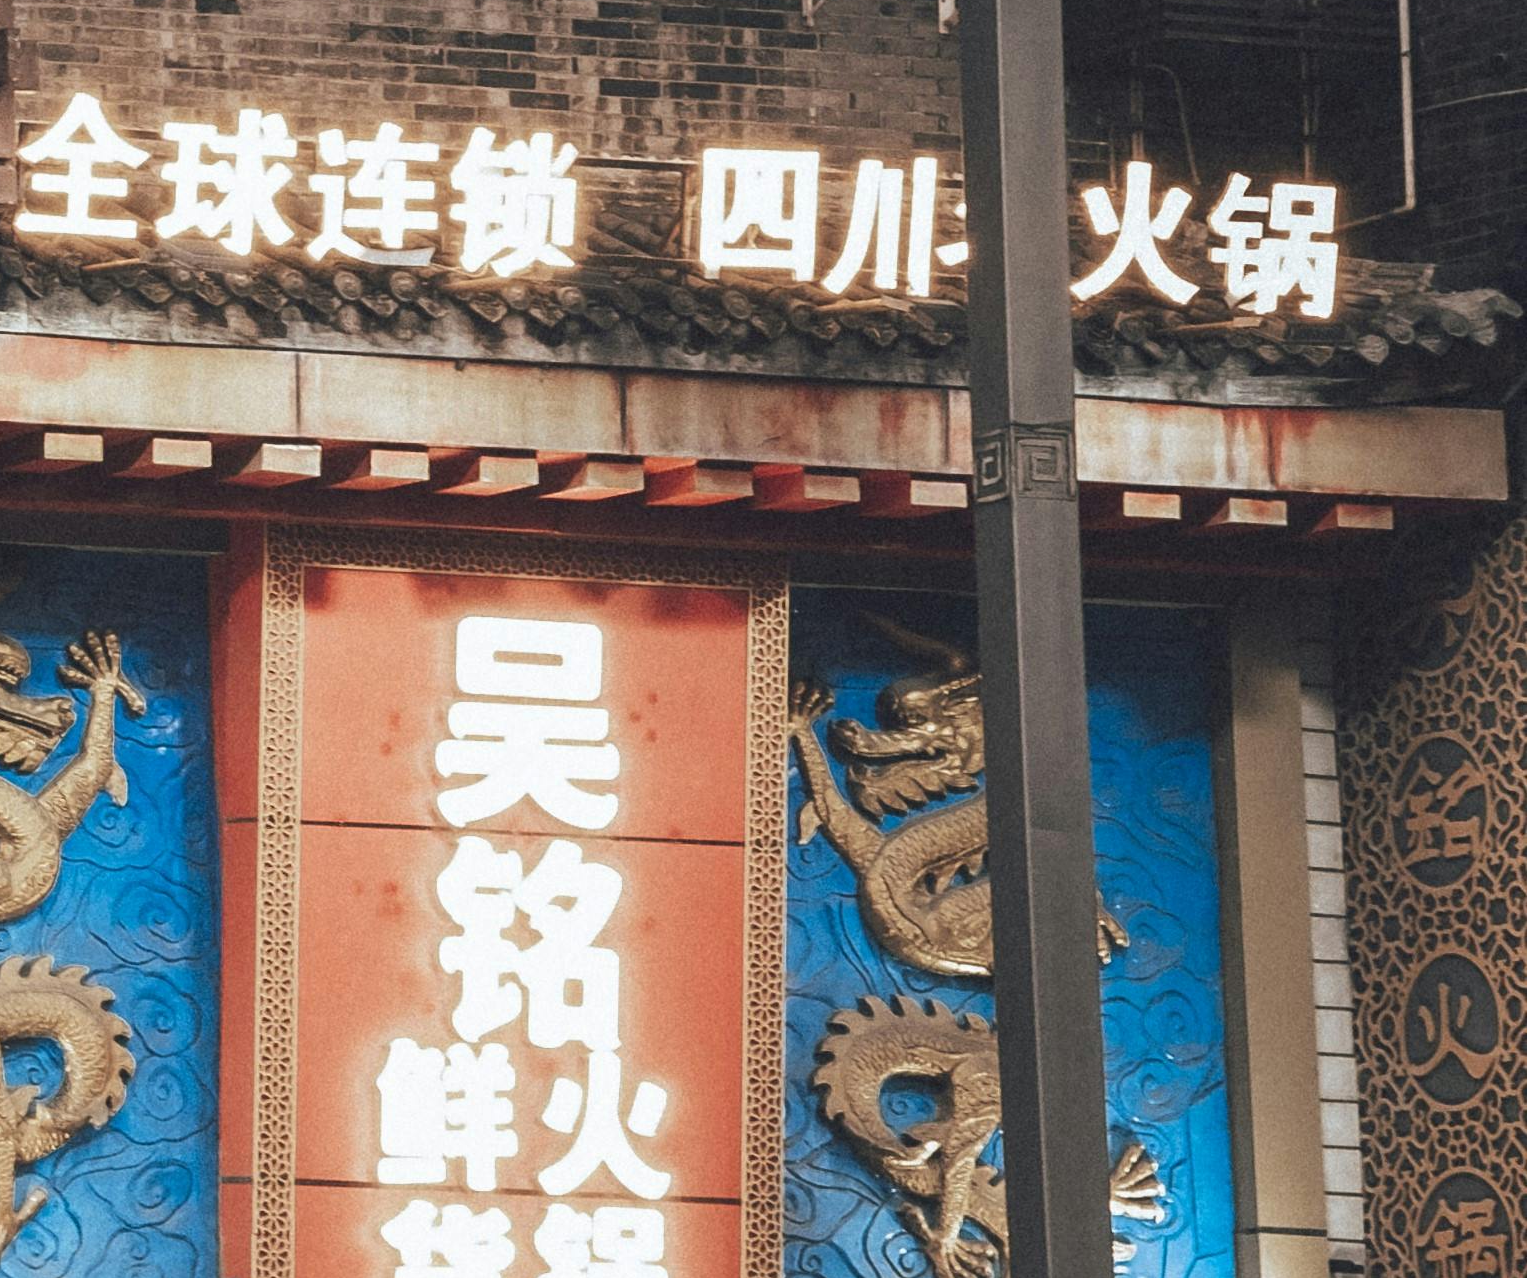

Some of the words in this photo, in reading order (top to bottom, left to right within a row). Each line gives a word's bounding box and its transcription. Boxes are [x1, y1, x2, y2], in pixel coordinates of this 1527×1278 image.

[15, 93, 576, 278] 全球连锁
[698, 145, 1340, 320] 四川火锅
[434, 615, 621, 1053] 吴铭
